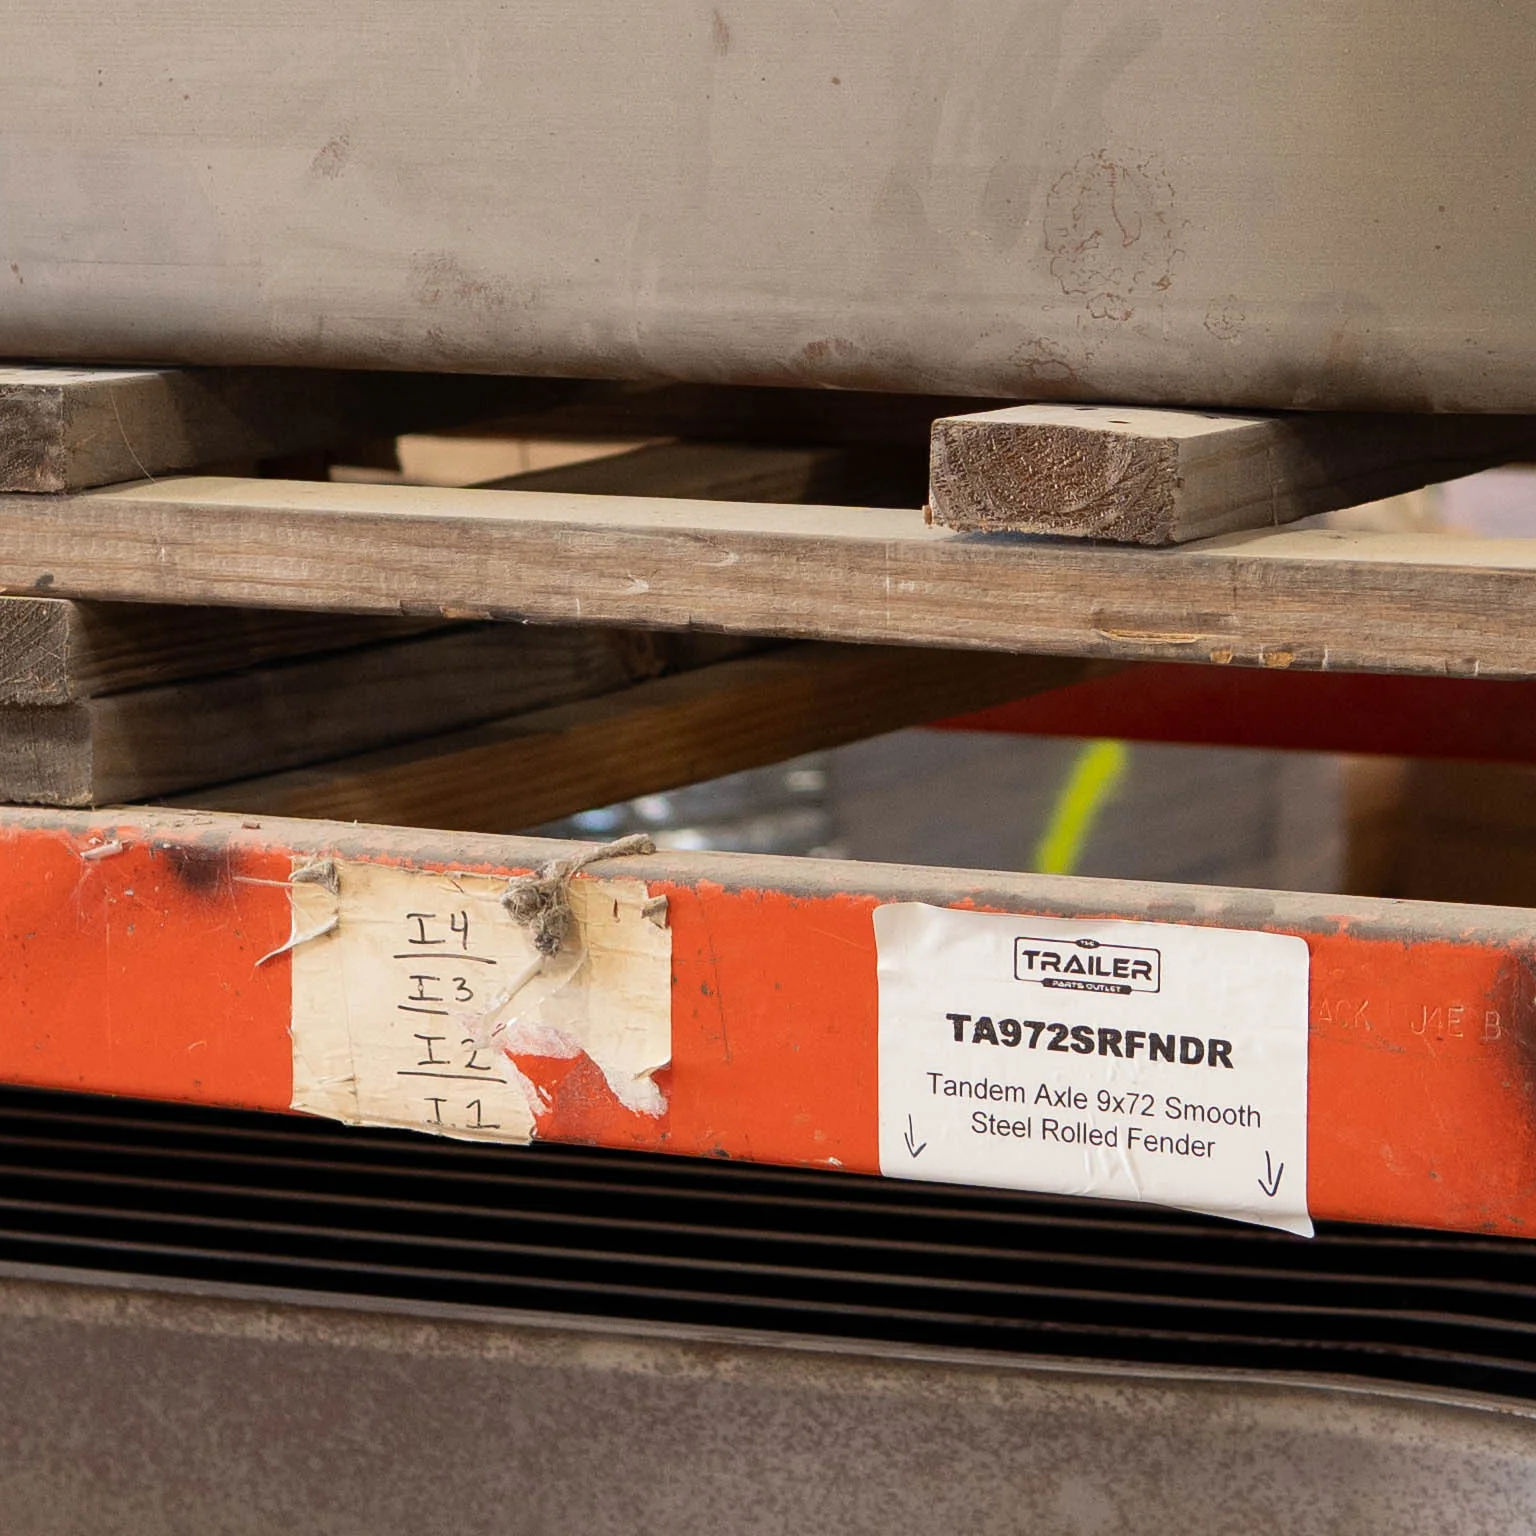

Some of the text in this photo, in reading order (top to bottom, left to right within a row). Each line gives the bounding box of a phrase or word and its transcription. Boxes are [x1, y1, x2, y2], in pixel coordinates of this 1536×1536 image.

[406, 910, 470, 950] I4
[1022, 949, 1152, 981] TRAILER
[408, 975, 474, 1002] I3
[1052, 980, 1121, 993] PARTS OUTLET
[413, 1033, 492, 1070] I2
[946, 1013, 1234, 1068] TA972SRFNDR
[927, 1072, 1261, 1128] Tandem Axle 9x72 Smooth
[971, 1111, 1216, 1157] Steel Rolled Fender
